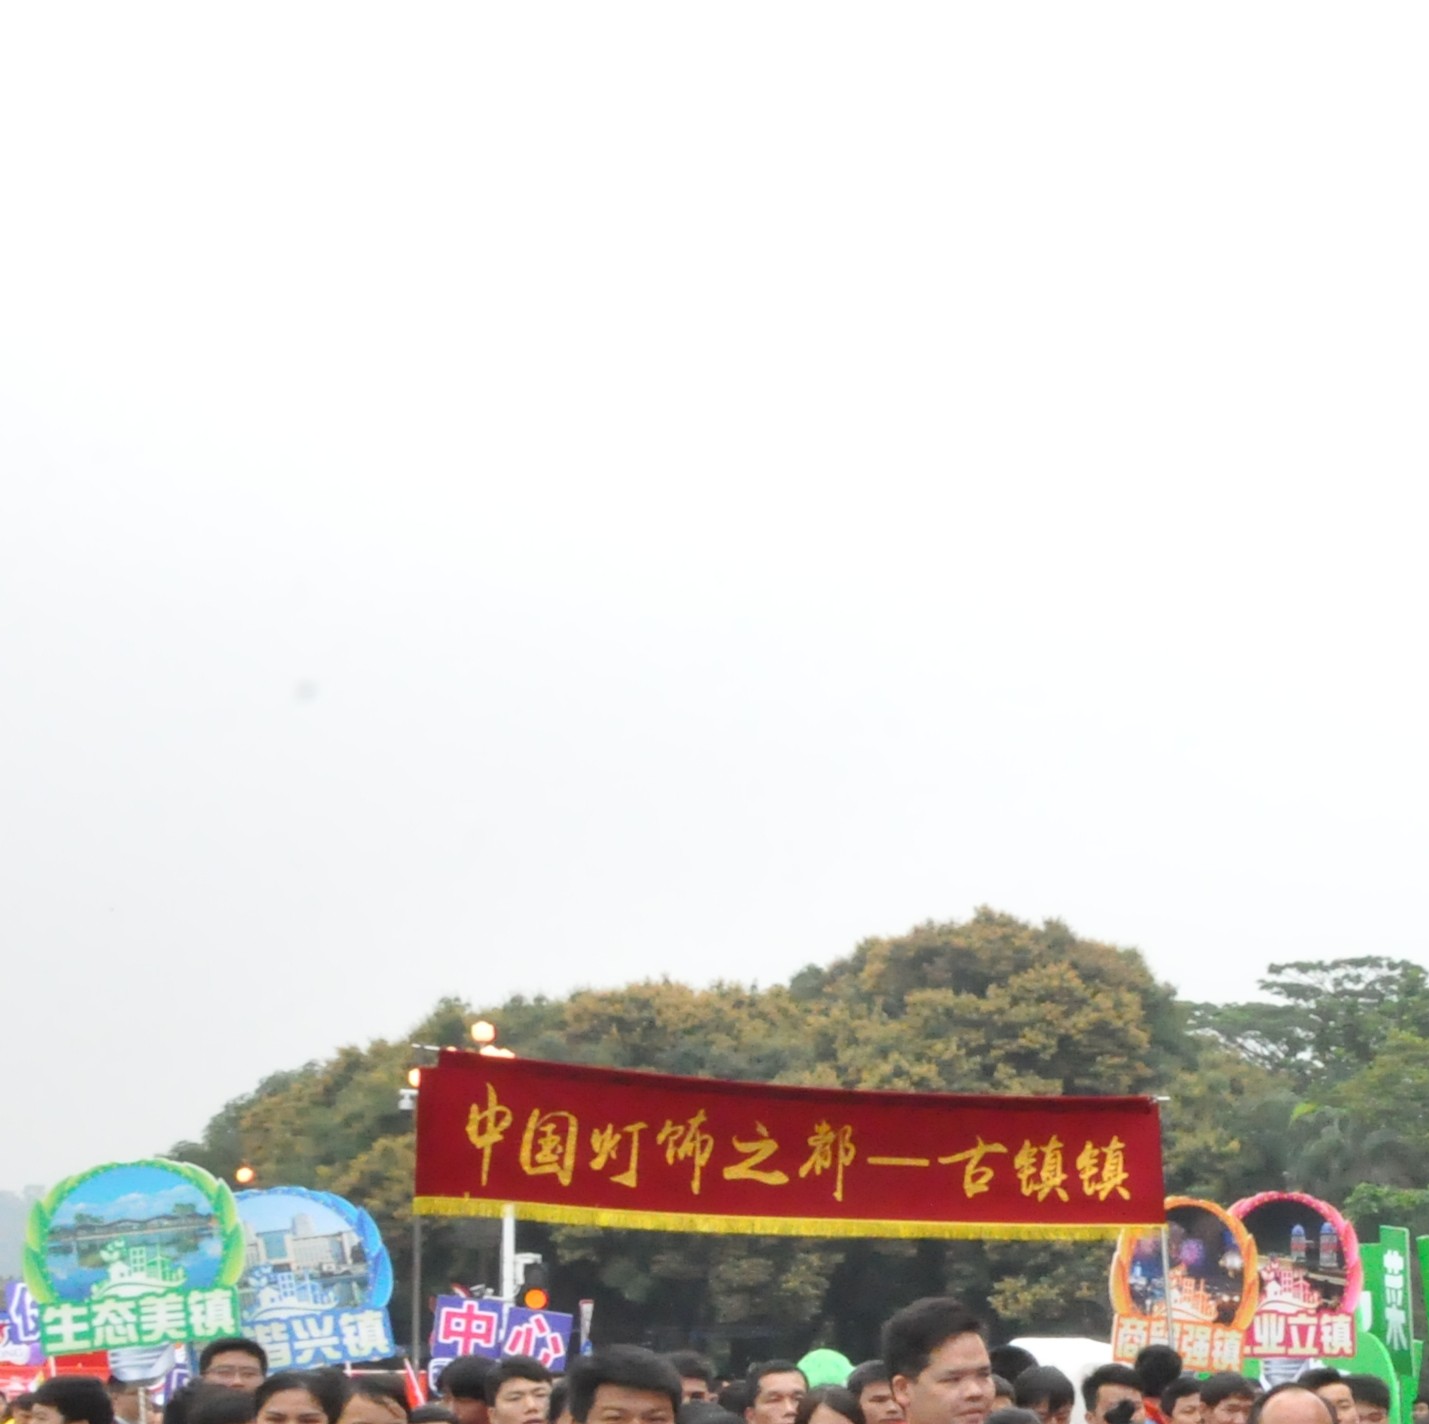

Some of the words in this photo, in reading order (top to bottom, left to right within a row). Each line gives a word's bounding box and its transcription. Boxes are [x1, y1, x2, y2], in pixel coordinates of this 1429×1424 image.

[42, 1289, 236, 1352] 生态美镇
[437, 1300, 566, 1368] 中心
[1244, 1312, 1353, 1356] 业立镇
